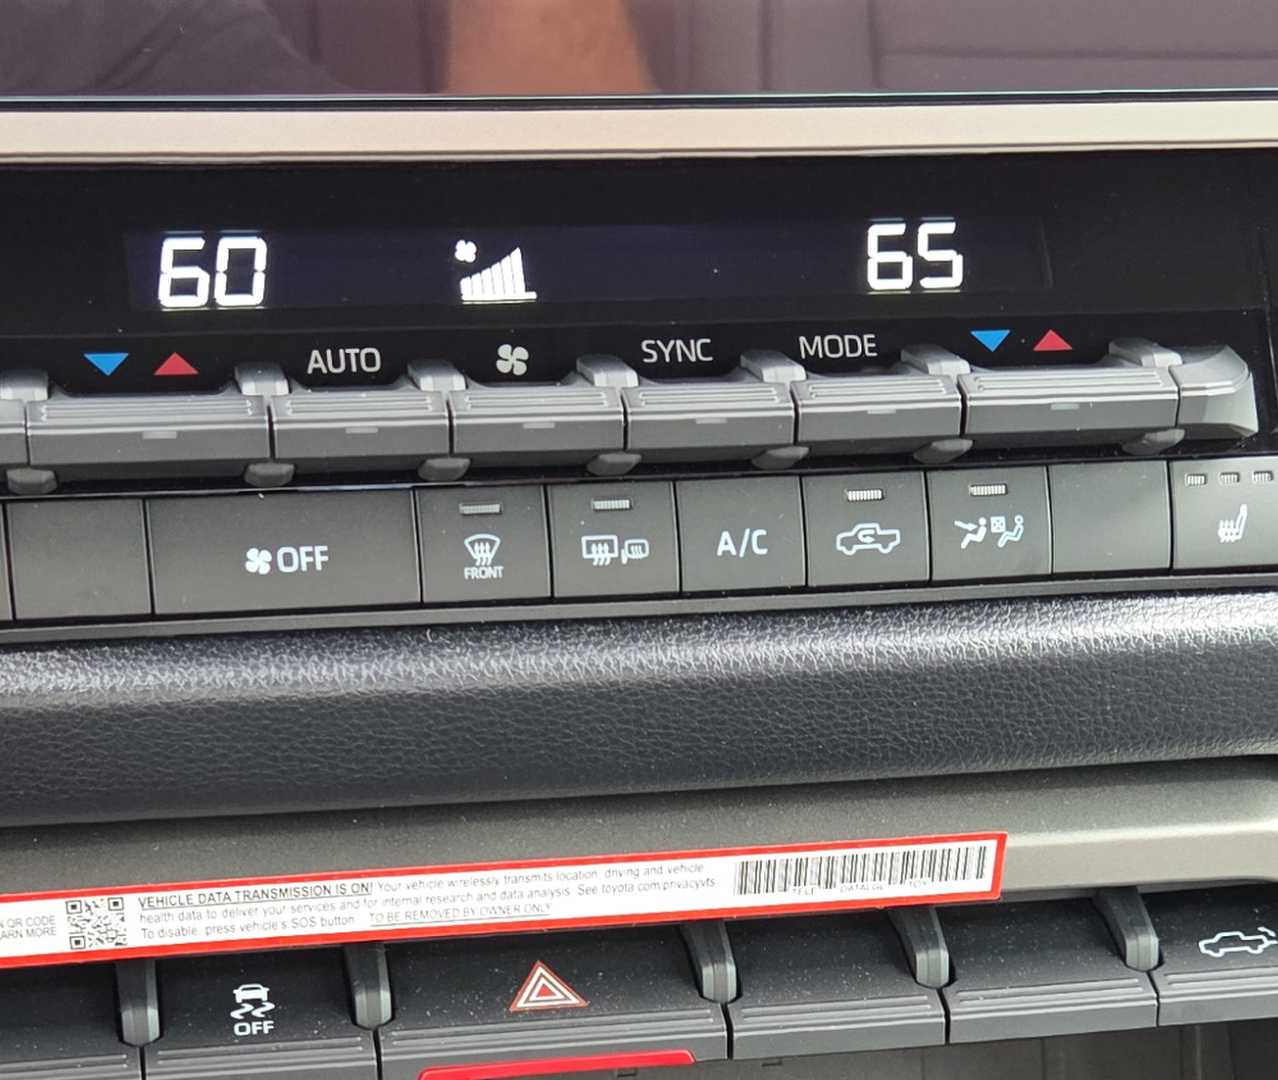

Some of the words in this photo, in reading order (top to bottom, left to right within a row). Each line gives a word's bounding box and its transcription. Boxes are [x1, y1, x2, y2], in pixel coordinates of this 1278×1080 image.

[867, 221, 964, 291] 65
[158, 235, 268, 308] 60
[306, 346, 382, 375] AUTO
[640, 338, 714, 364] SYNC
[798, 333, 878, 360] MODE
[716, 527, 769, 558] A/C
[276, 543, 329, 574] OFF
[463, 564, 505, 580] FRONT
[138, 893, 194, 909] VEHICLE
[198, 891, 232, 905] DATA
[234, 884, 332, 903] TRANSMISSION
[335, 883, 347, 895] IS
[350, 882, 373, 895] ON!
[377, 881, 402, 893] Your
[406, 879, 444, 890] vehicle
[447, 876, 500, 887] wirelessly
[503, 873, 553, 885] transmits
[643, 865, 663, 877] and
[667, 863, 704, 875] vehicle
[139, 911, 174, 924] health
[178, 910, 203, 922] data
[206, 909, 217, 920] to
[222, 907, 258, 918] deliver
[262, 905, 286, 918] your
[290, 902, 336, 914] services
[340, 899, 360, 911] and
[426, 892, 473, 905] research
[476, 891, 497, 902] and
[500, 890, 523, 901] data
[578, 883, 598, 896] See
[6, 918, 23, 928] QR
[25, 915, 56, 927] CODE
[25, 926, 57, 938] MORE
[141, 927, 155, 939] To
[205, 924, 236, 936] press
[291, 915, 317, 929] SOS
[369, 912, 384, 923] TO
[387, 911, 400, 922] BE
[404, 907, 460, 920] REMOVED
[463, 906, 476, 918] BY
[479, 904, 521, 916] OWNER
[523, 902, 552, 914] ONLY
[233, 1020, 275, 1037] OFF
